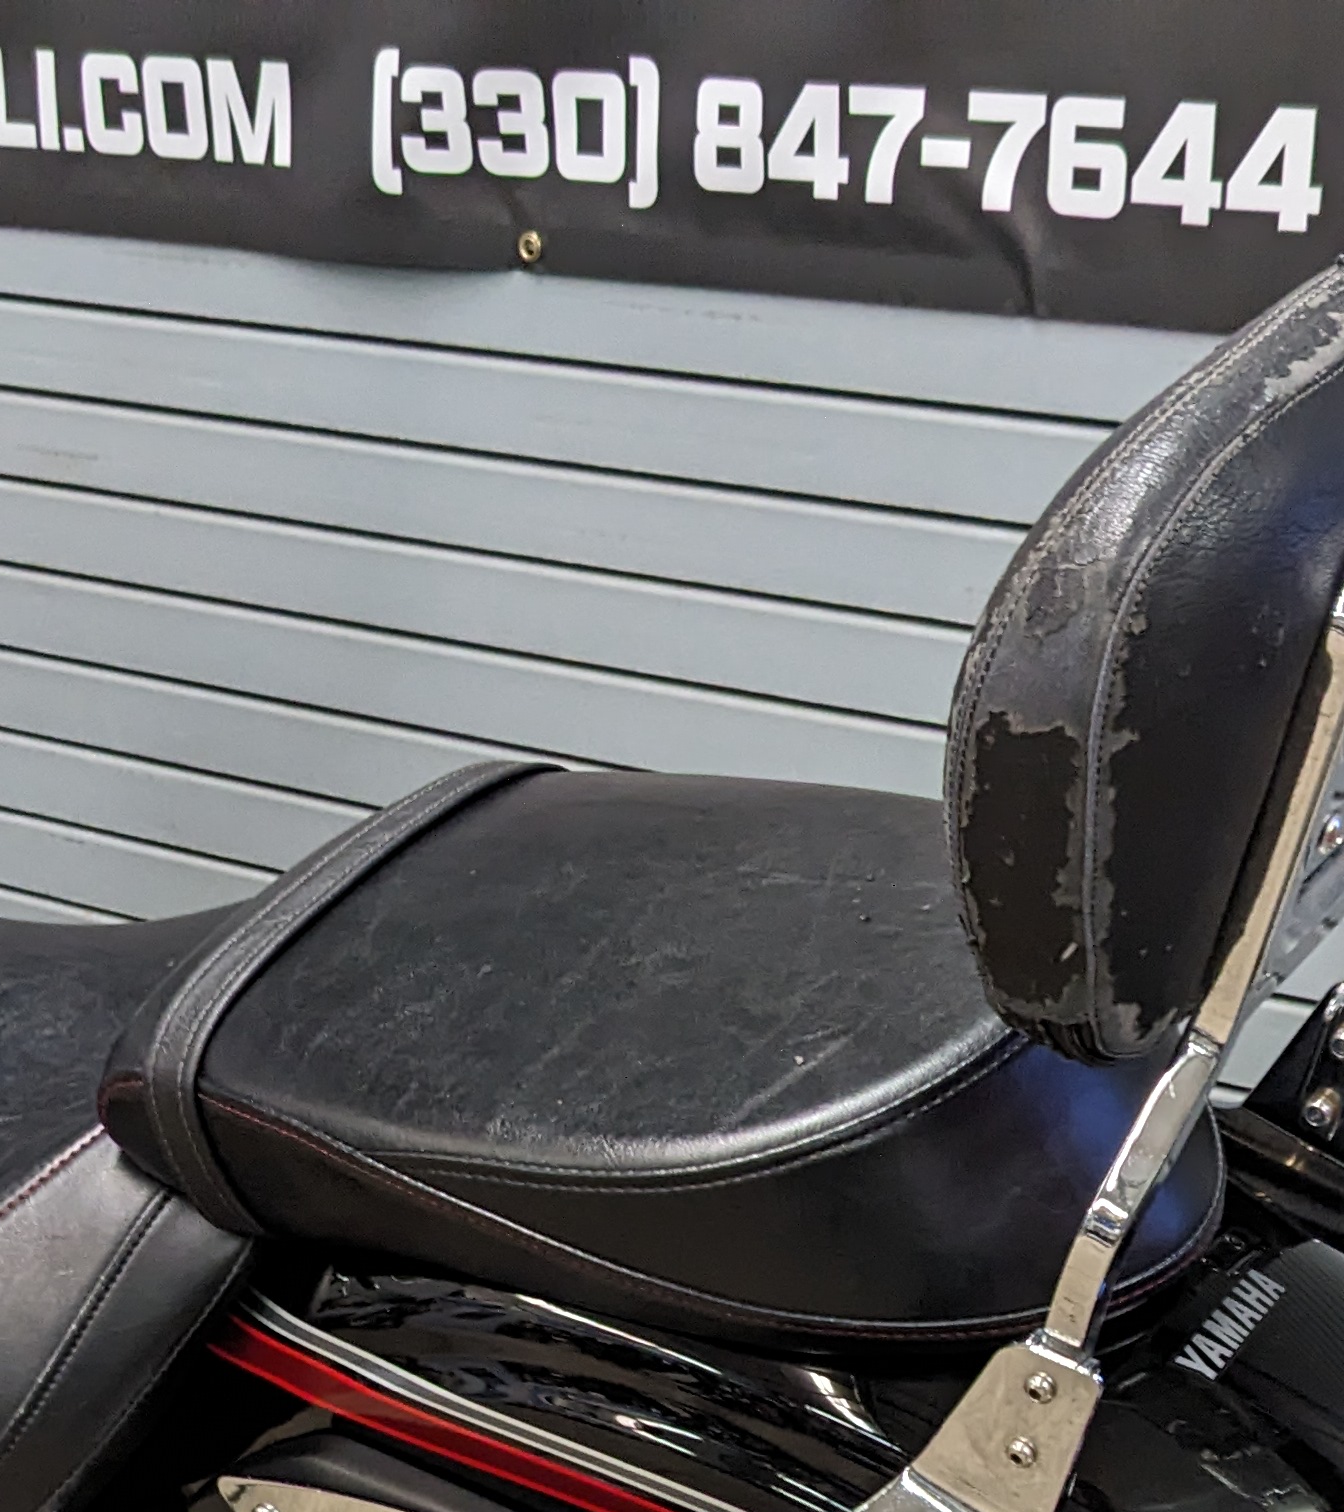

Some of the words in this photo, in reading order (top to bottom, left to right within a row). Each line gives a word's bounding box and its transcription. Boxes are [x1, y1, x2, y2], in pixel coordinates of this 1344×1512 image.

[371, 47, 660, 209] (330)
[693, 77, 1323, 233] 847-7644
[1174, 1268, 1286, 1381] YAMAHA
